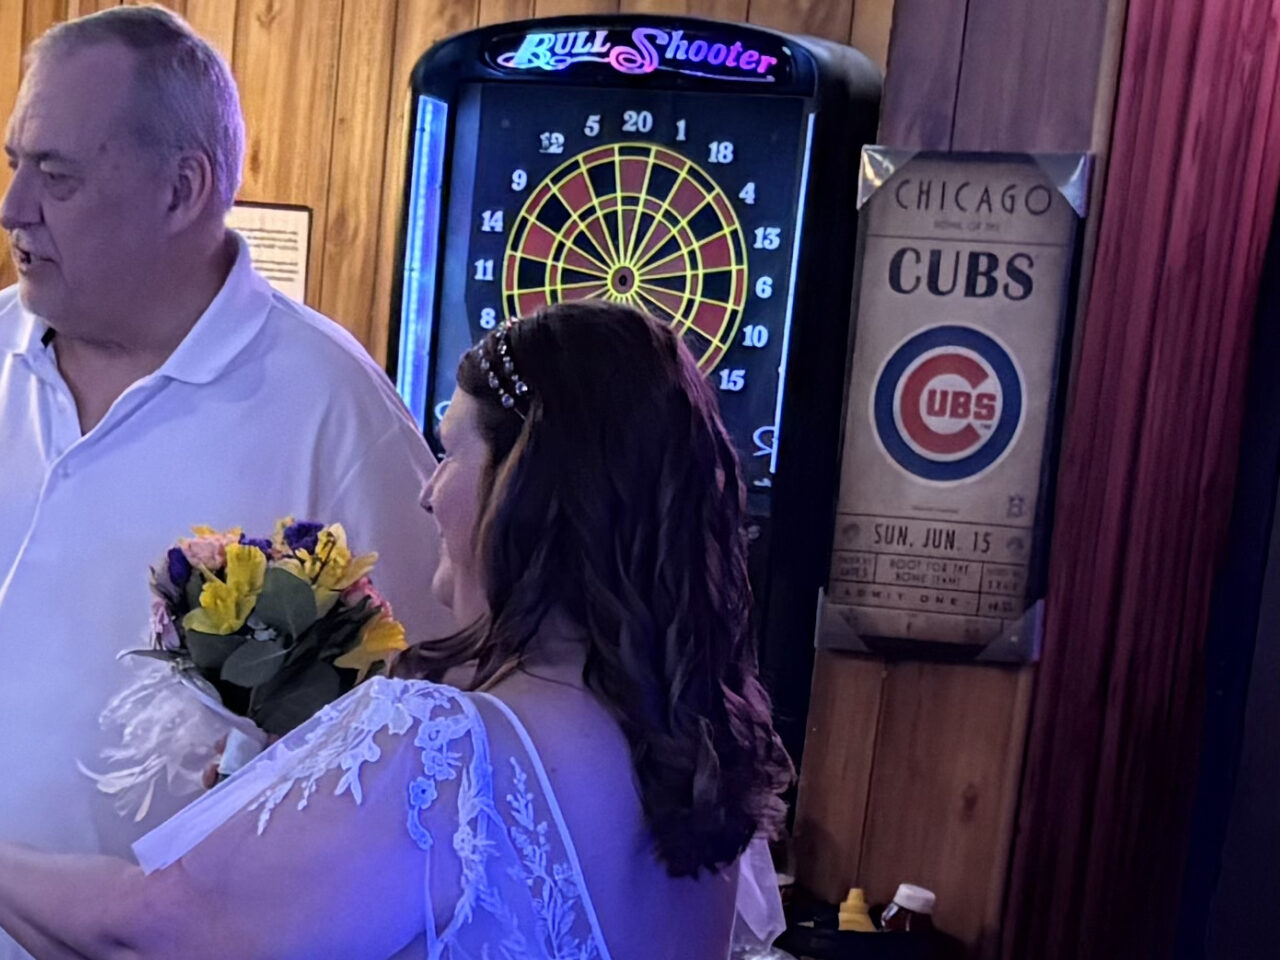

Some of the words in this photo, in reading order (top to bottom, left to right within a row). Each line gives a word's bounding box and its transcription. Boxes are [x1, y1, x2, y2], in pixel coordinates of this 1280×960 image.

[497, 31, 611, 70] BULL
[609, 27, 777, 74] Shooter
[584, 114, 600, 137] 5
[622, 110, 653, 132] 20
[675, 119, 687, 141] 1
[708, 141, 734, 164] 18
[511, 169, 527, 191] 9
[739, 182, 756, 204] 4
[895, 178, 1052, 216] CHICAGO
[480, 209, 503, 232] 14
[753, 227, 781, 250] 13
[474, 260, 494, 281] 11
[888, 247, 1034, 301] CUBS
[756, 276, 772, 299] 6
[480, 308, 495, 328] 8
[743, 325, 768, 347] 10
[720, 368, 745, 392] 15
[900, 353, 997, 455] CUBS
[874, 523, 914, 548] SUN.
[972, 531, 993, 554] 15
[919, 594, 959, 606] ONE
